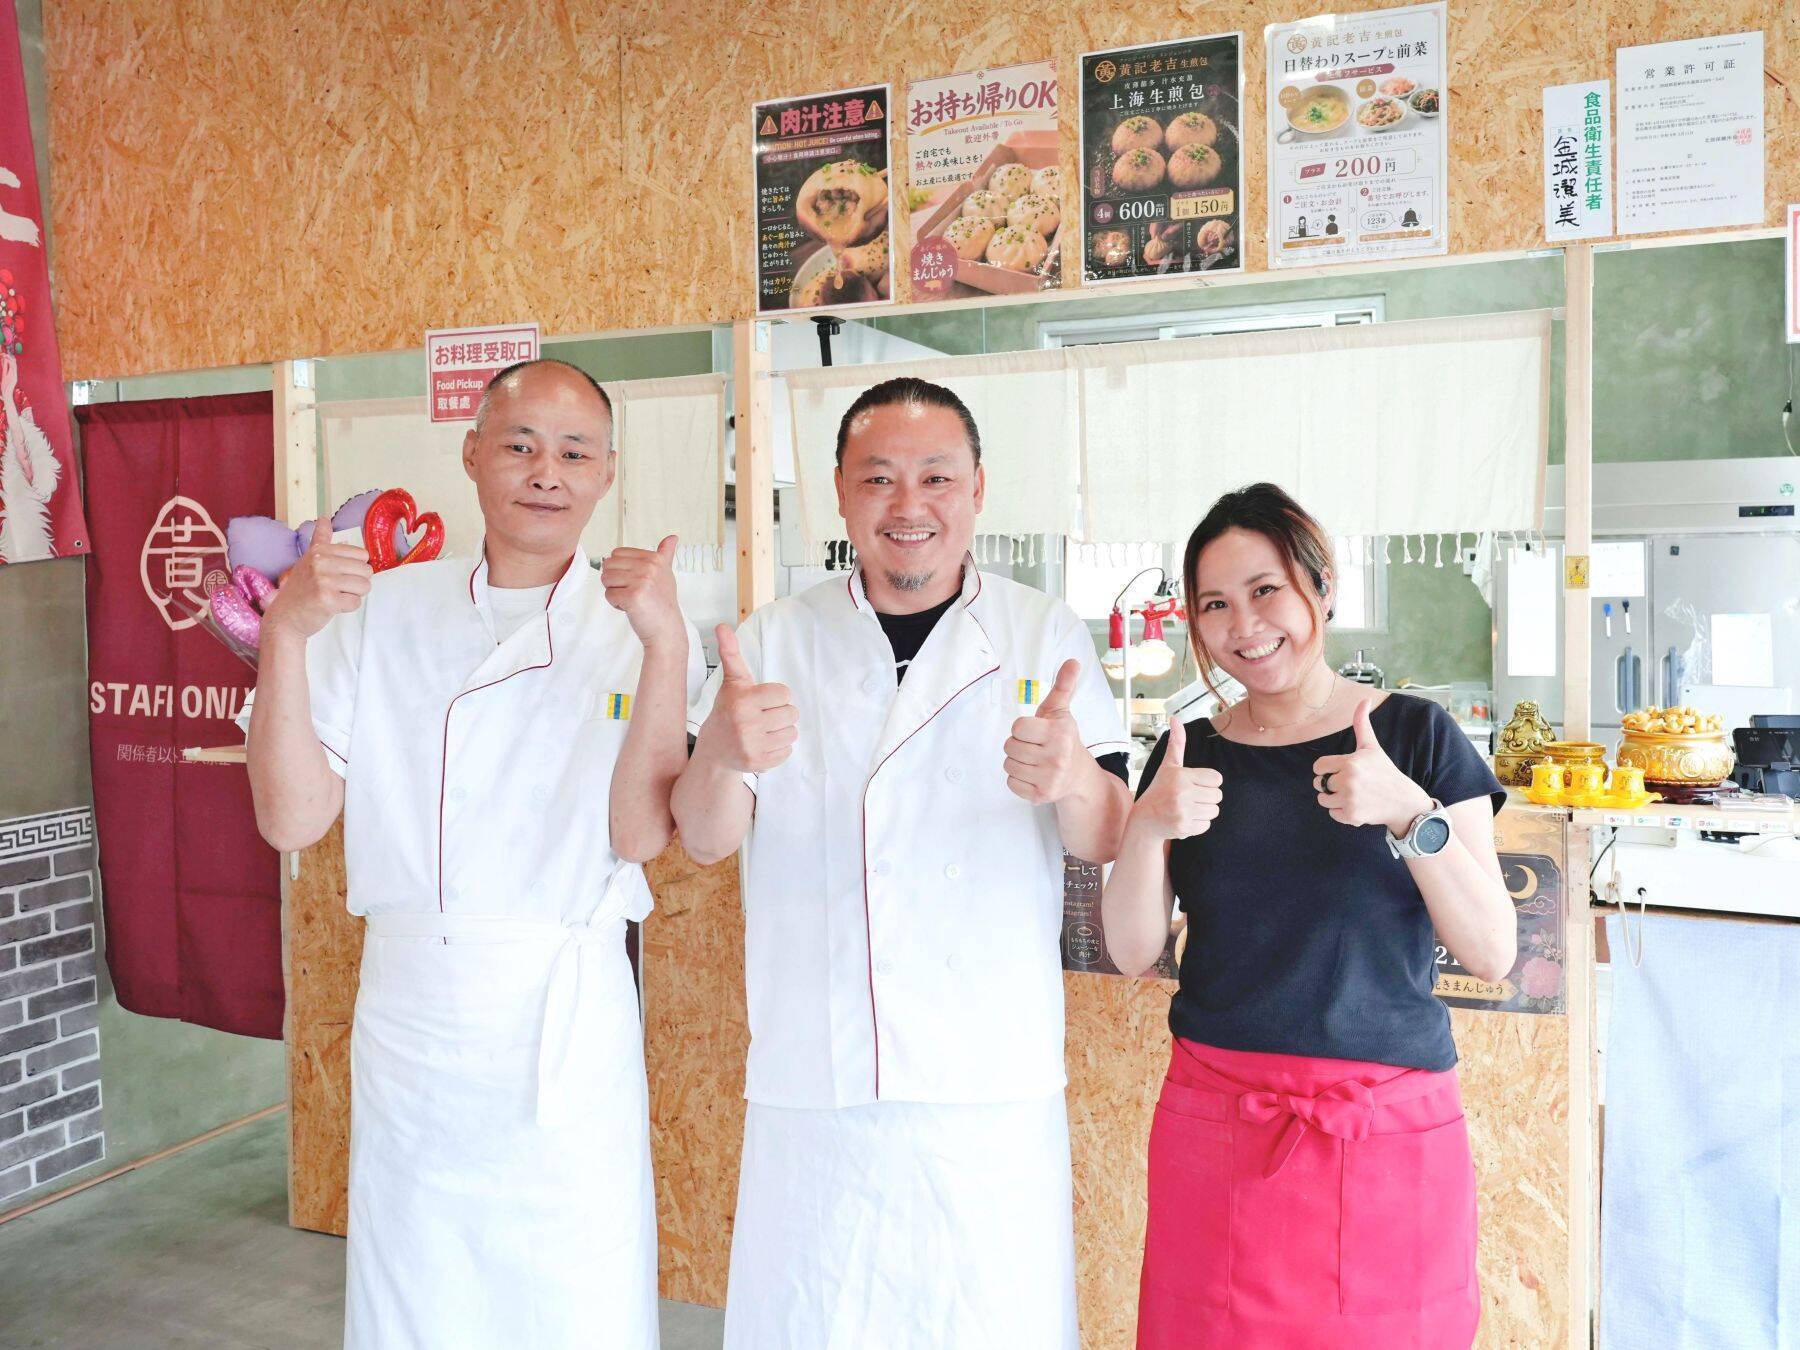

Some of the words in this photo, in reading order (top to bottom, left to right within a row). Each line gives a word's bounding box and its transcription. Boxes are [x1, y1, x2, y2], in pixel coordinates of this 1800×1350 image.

[1284, 40, 1428, 74] 日替わりスープと前菜
[1644, 58, 1736, 80] 営業許可証
[910, 80, 1057, 127] お持ち帰りOK
[1108, 83, 1205, 110] 上海生煎包
[780, 99, 865, 135] 肉汁注意
[943, 127, 969, 136] Takeout
[971, 122, 999, 133] Available
[1013, 119, 1023, 127] Go
[794, 139, 807, 149] HOT
[915, 147, 952, 160] ご自宅でも
[1584, 91, 1603, 211] 食品衛生責任者
[1335, 155, 1396, 178] 200円
[921, 251, 944, 267] 焼き
[913, 264, 954, 281] まんじゅう
[435, 340, 532, 366] お料理受取口
[436, 380, 455, 391] Food
[456, 378, 484, 392] Pickup
